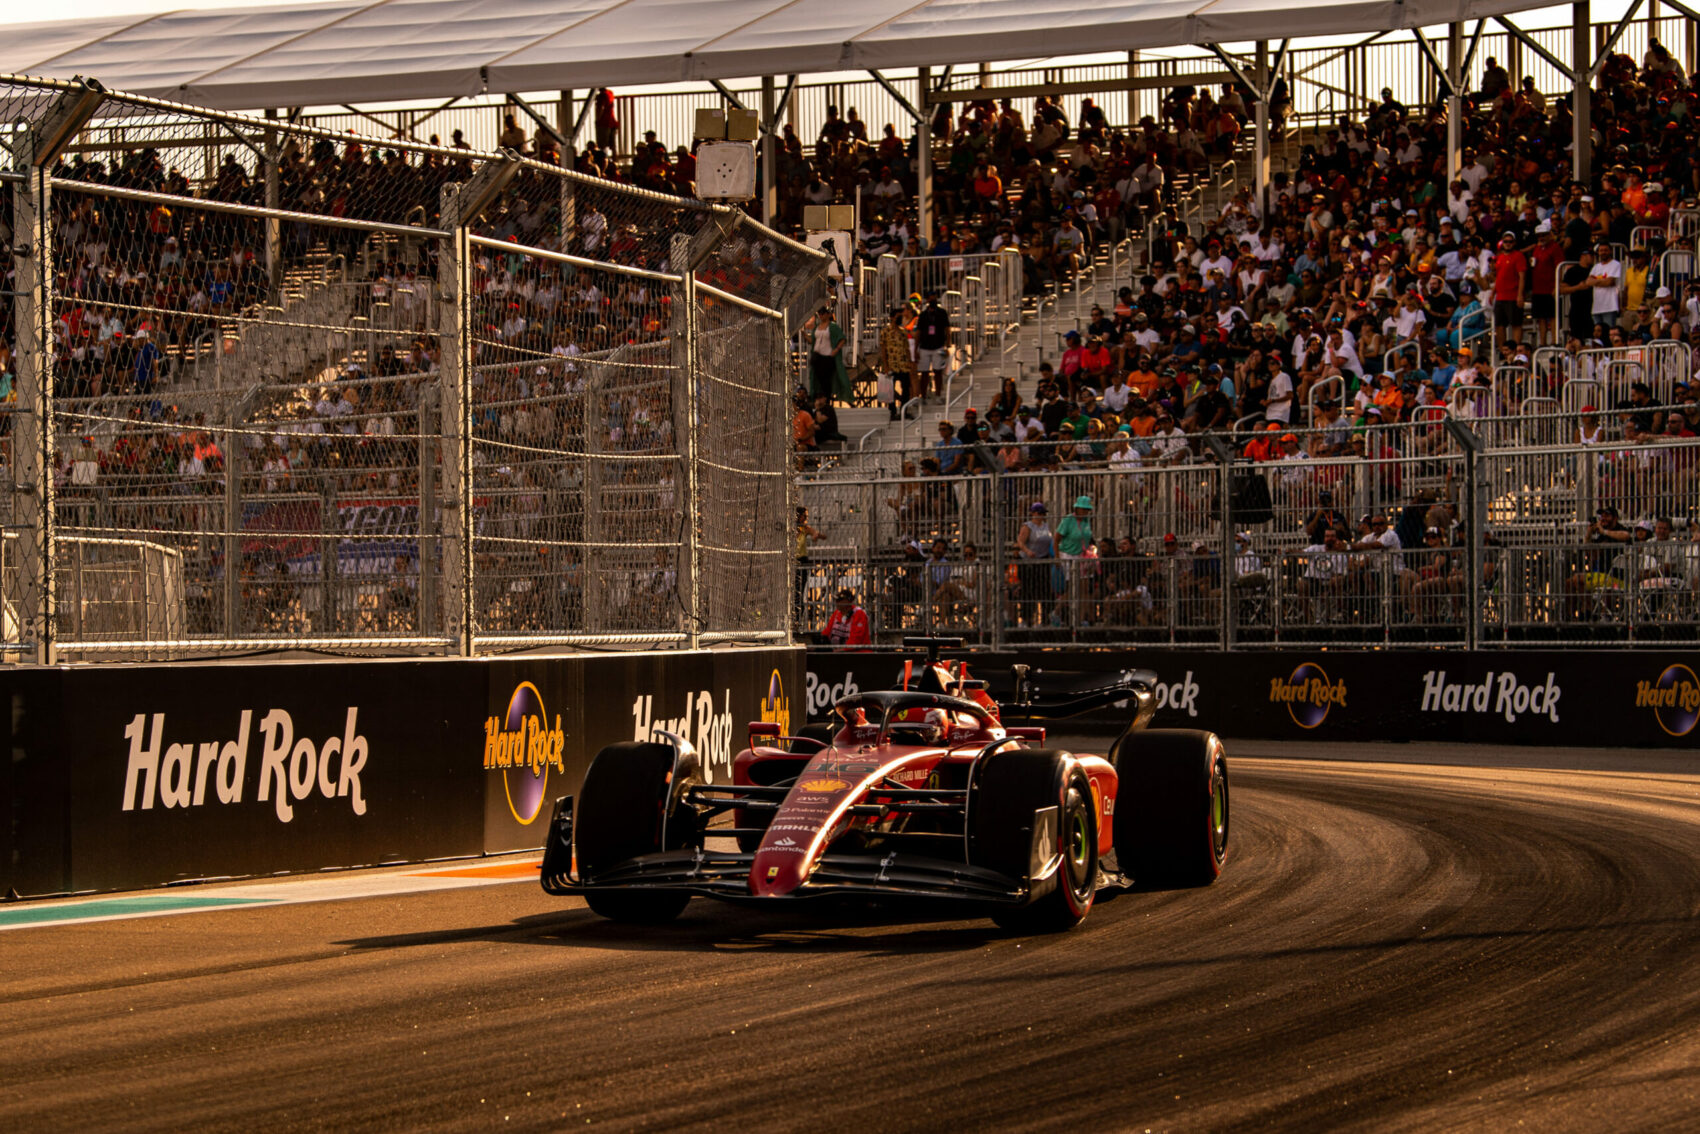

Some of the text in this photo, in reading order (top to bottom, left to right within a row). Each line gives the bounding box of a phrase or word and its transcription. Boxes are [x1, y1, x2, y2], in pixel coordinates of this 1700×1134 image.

[1152, 671, 1199, 717] ock
[1270, 678, 1347, 708] Hard Rock
[1421, 671, 1561, 722] Hard Rock
[1636, 680, 1700, 713] Hard Ro
[483, 714, 565, 777] Hard Rock
[695, 688, 732, 785] Rock
[122, 706, 369, 823] Hard Rock
